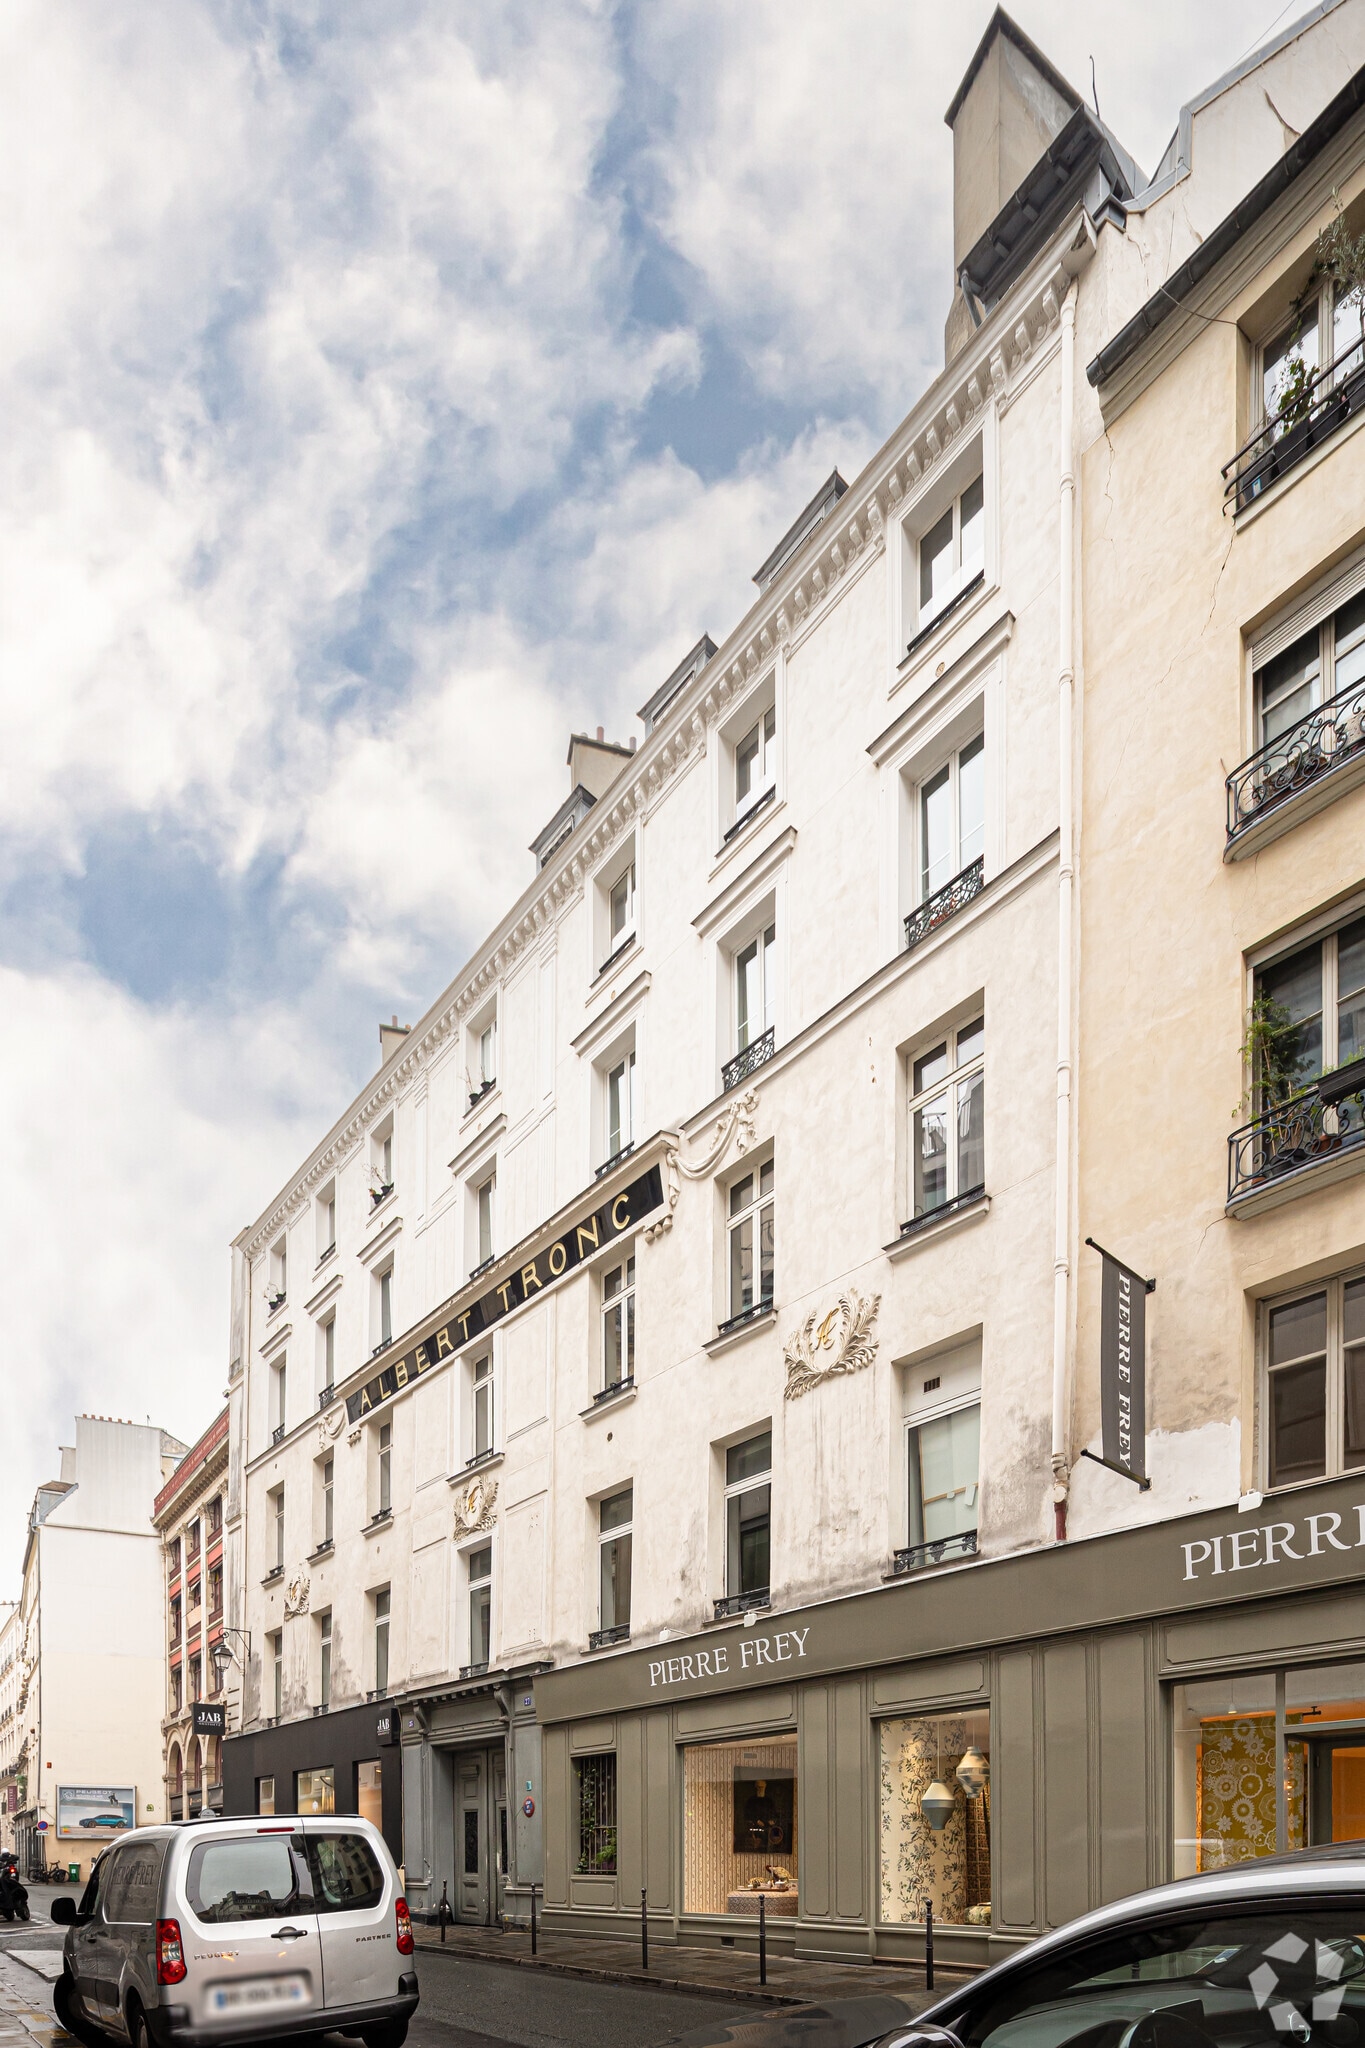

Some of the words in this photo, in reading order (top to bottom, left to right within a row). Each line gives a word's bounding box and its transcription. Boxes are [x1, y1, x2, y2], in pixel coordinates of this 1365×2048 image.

[361, 1310, 471, 1415] ALBERT
[496, 1193, 631, 1312] TRONC
[1118, 1272, 1131, 1384] PIERRE
[1118, 1391, 1131, 1470] FREY
[648, 1647, 730, 1687] PIERRE
[739, 1627, 810, 1669] FREY
[198, 1711, 222, 1722] JAB
[377, 1718, 390, 1730] JAB
[134, 1865, 157, 1886] FREY
[355, 1933, 392, 1943] PARTNER
[194, 1950, 239, 1961] PEUGEOT
